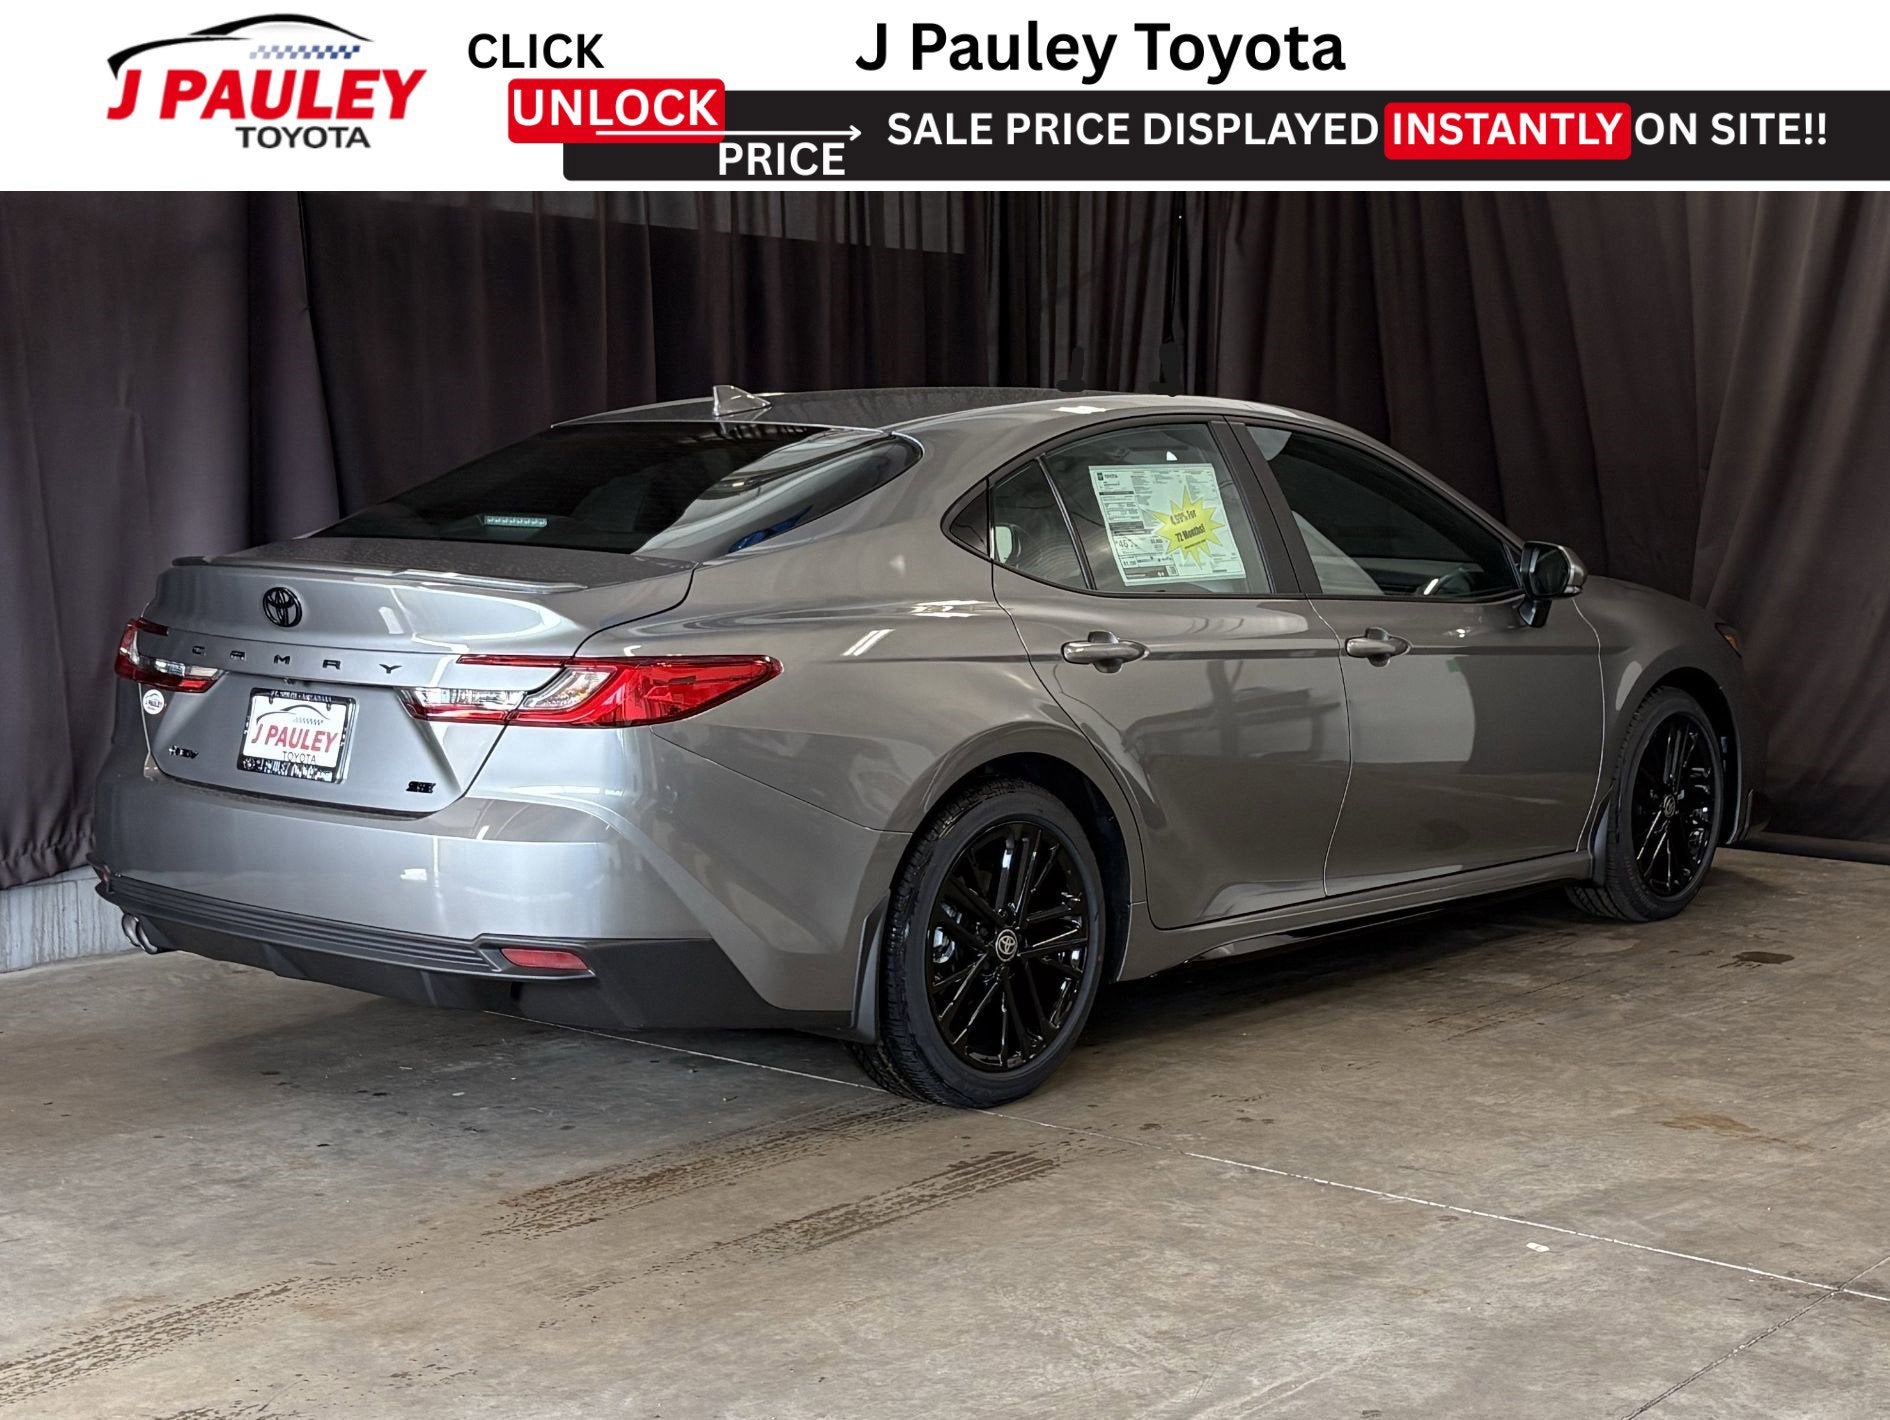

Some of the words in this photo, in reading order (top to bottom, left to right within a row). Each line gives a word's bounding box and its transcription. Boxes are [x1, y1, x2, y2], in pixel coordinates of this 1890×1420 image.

[191, 645, 403, 675] CAMRY
[251, 723, 264, 744] J
[264, 724, 339, 753] PAULEY
[281, 750, 317, 764] TOYOTA
